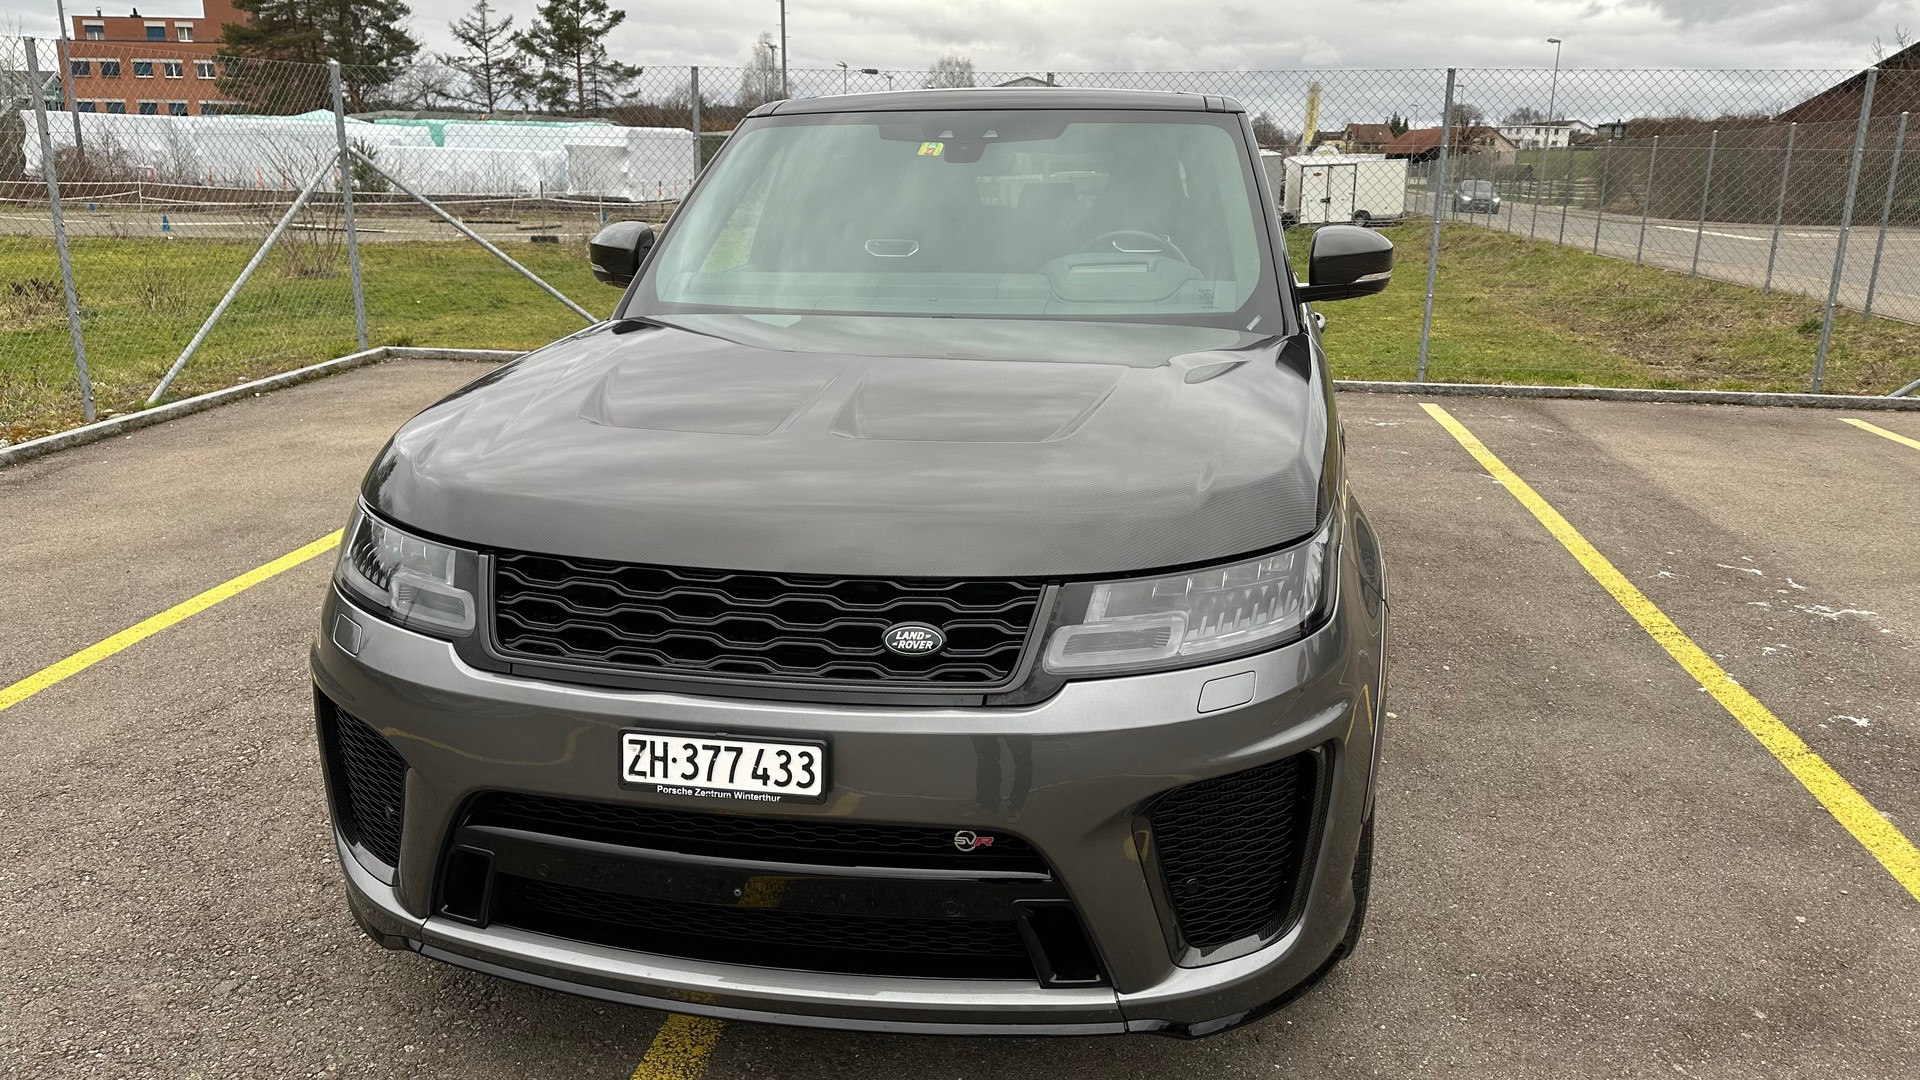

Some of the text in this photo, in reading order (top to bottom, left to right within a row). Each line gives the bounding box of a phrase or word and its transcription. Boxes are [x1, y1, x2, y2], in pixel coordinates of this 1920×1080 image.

[896, 631, 925, 640] LAND
[897, 640, 933, 650] ROVER
[656, 785, 781, 802] Porsche Zentrum Winterthur
[954, 830, 994, 852] SVR
